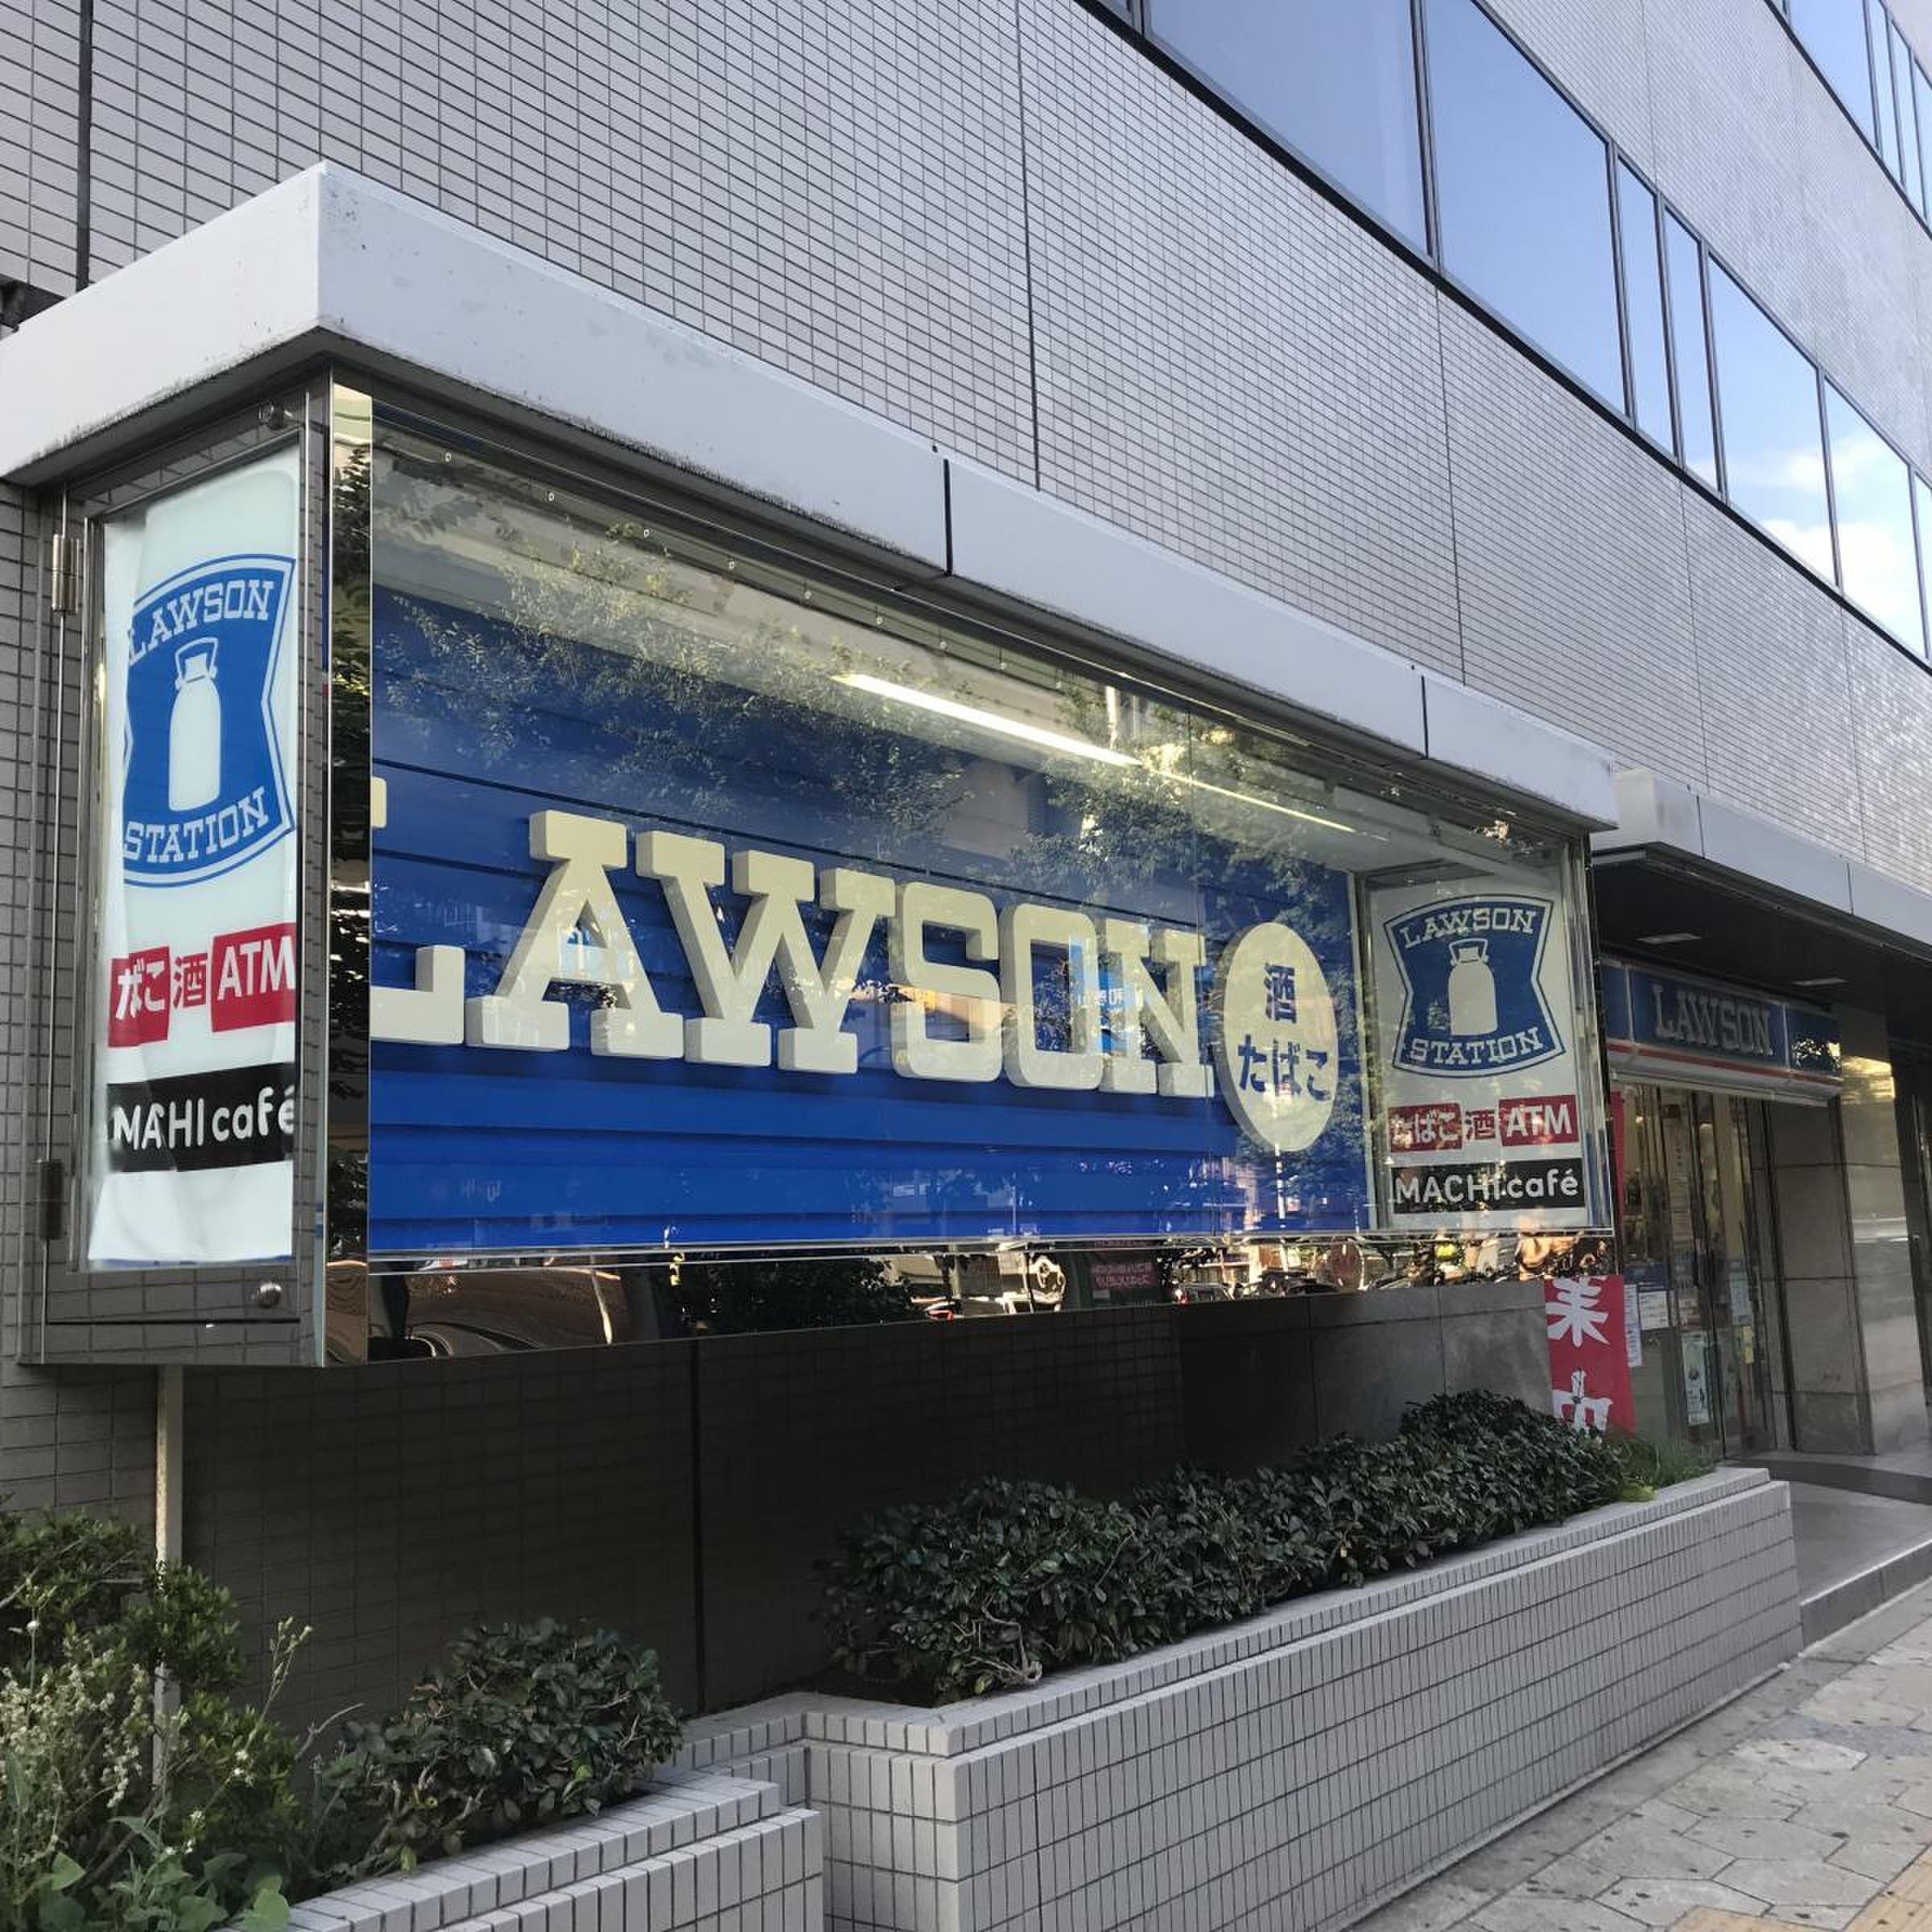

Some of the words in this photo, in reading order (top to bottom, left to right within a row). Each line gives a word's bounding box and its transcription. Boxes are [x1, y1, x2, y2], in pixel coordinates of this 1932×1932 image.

[124, 786, 270, 864] STATION
[1400, 907, 1536, 949] LAWSON
[217, 935, 295, 1001] ATM
[1264, 963, 1297, 1023] 酒
[1410, 1026, 1543, 1065] STATION
[1653, 983, 1774, 1057] LAWSON
[1237, 1034, 1330, 1102] たばこ
[112, 1098, 204, 1150] MAHI
[1506, 1104, 1572, 1137] ATM
